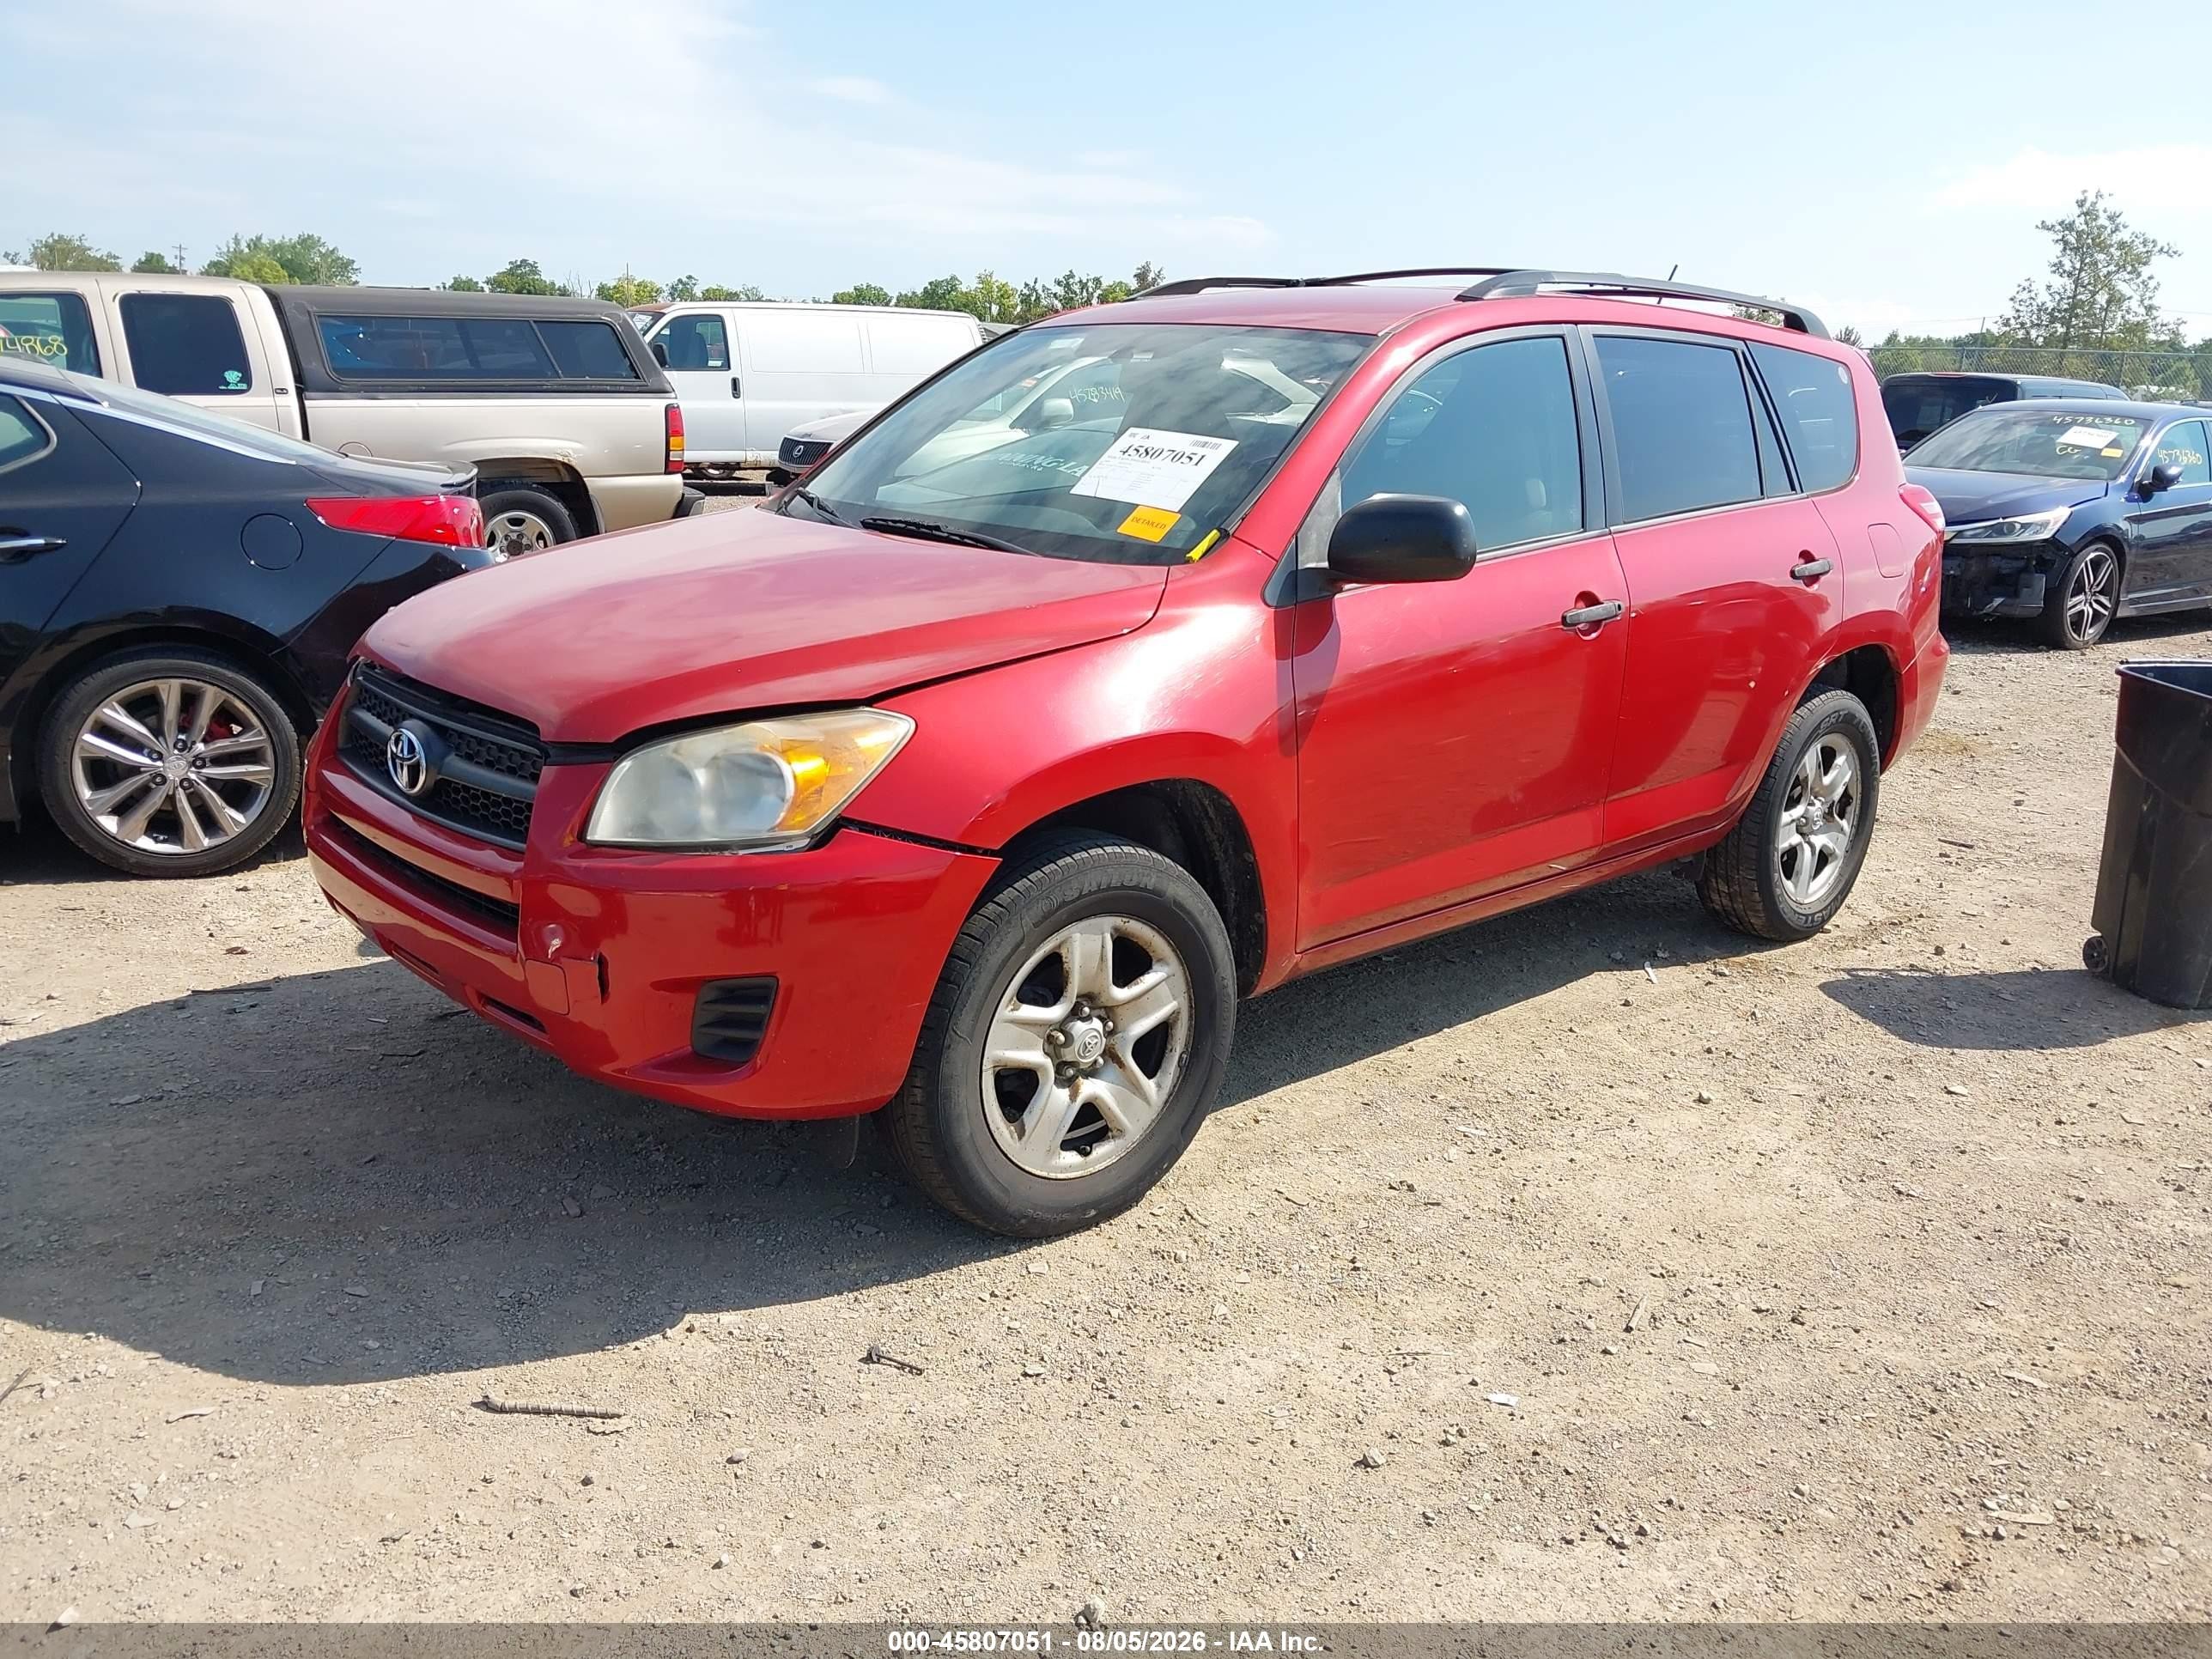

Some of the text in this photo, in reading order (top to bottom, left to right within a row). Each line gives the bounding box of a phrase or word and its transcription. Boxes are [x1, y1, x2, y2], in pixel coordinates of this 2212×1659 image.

[2053, 416, 2136, 425] 45736360
[1120, 444, 1207, 466] 45807051
[1131, 516, 1167, 530] DETAILED
